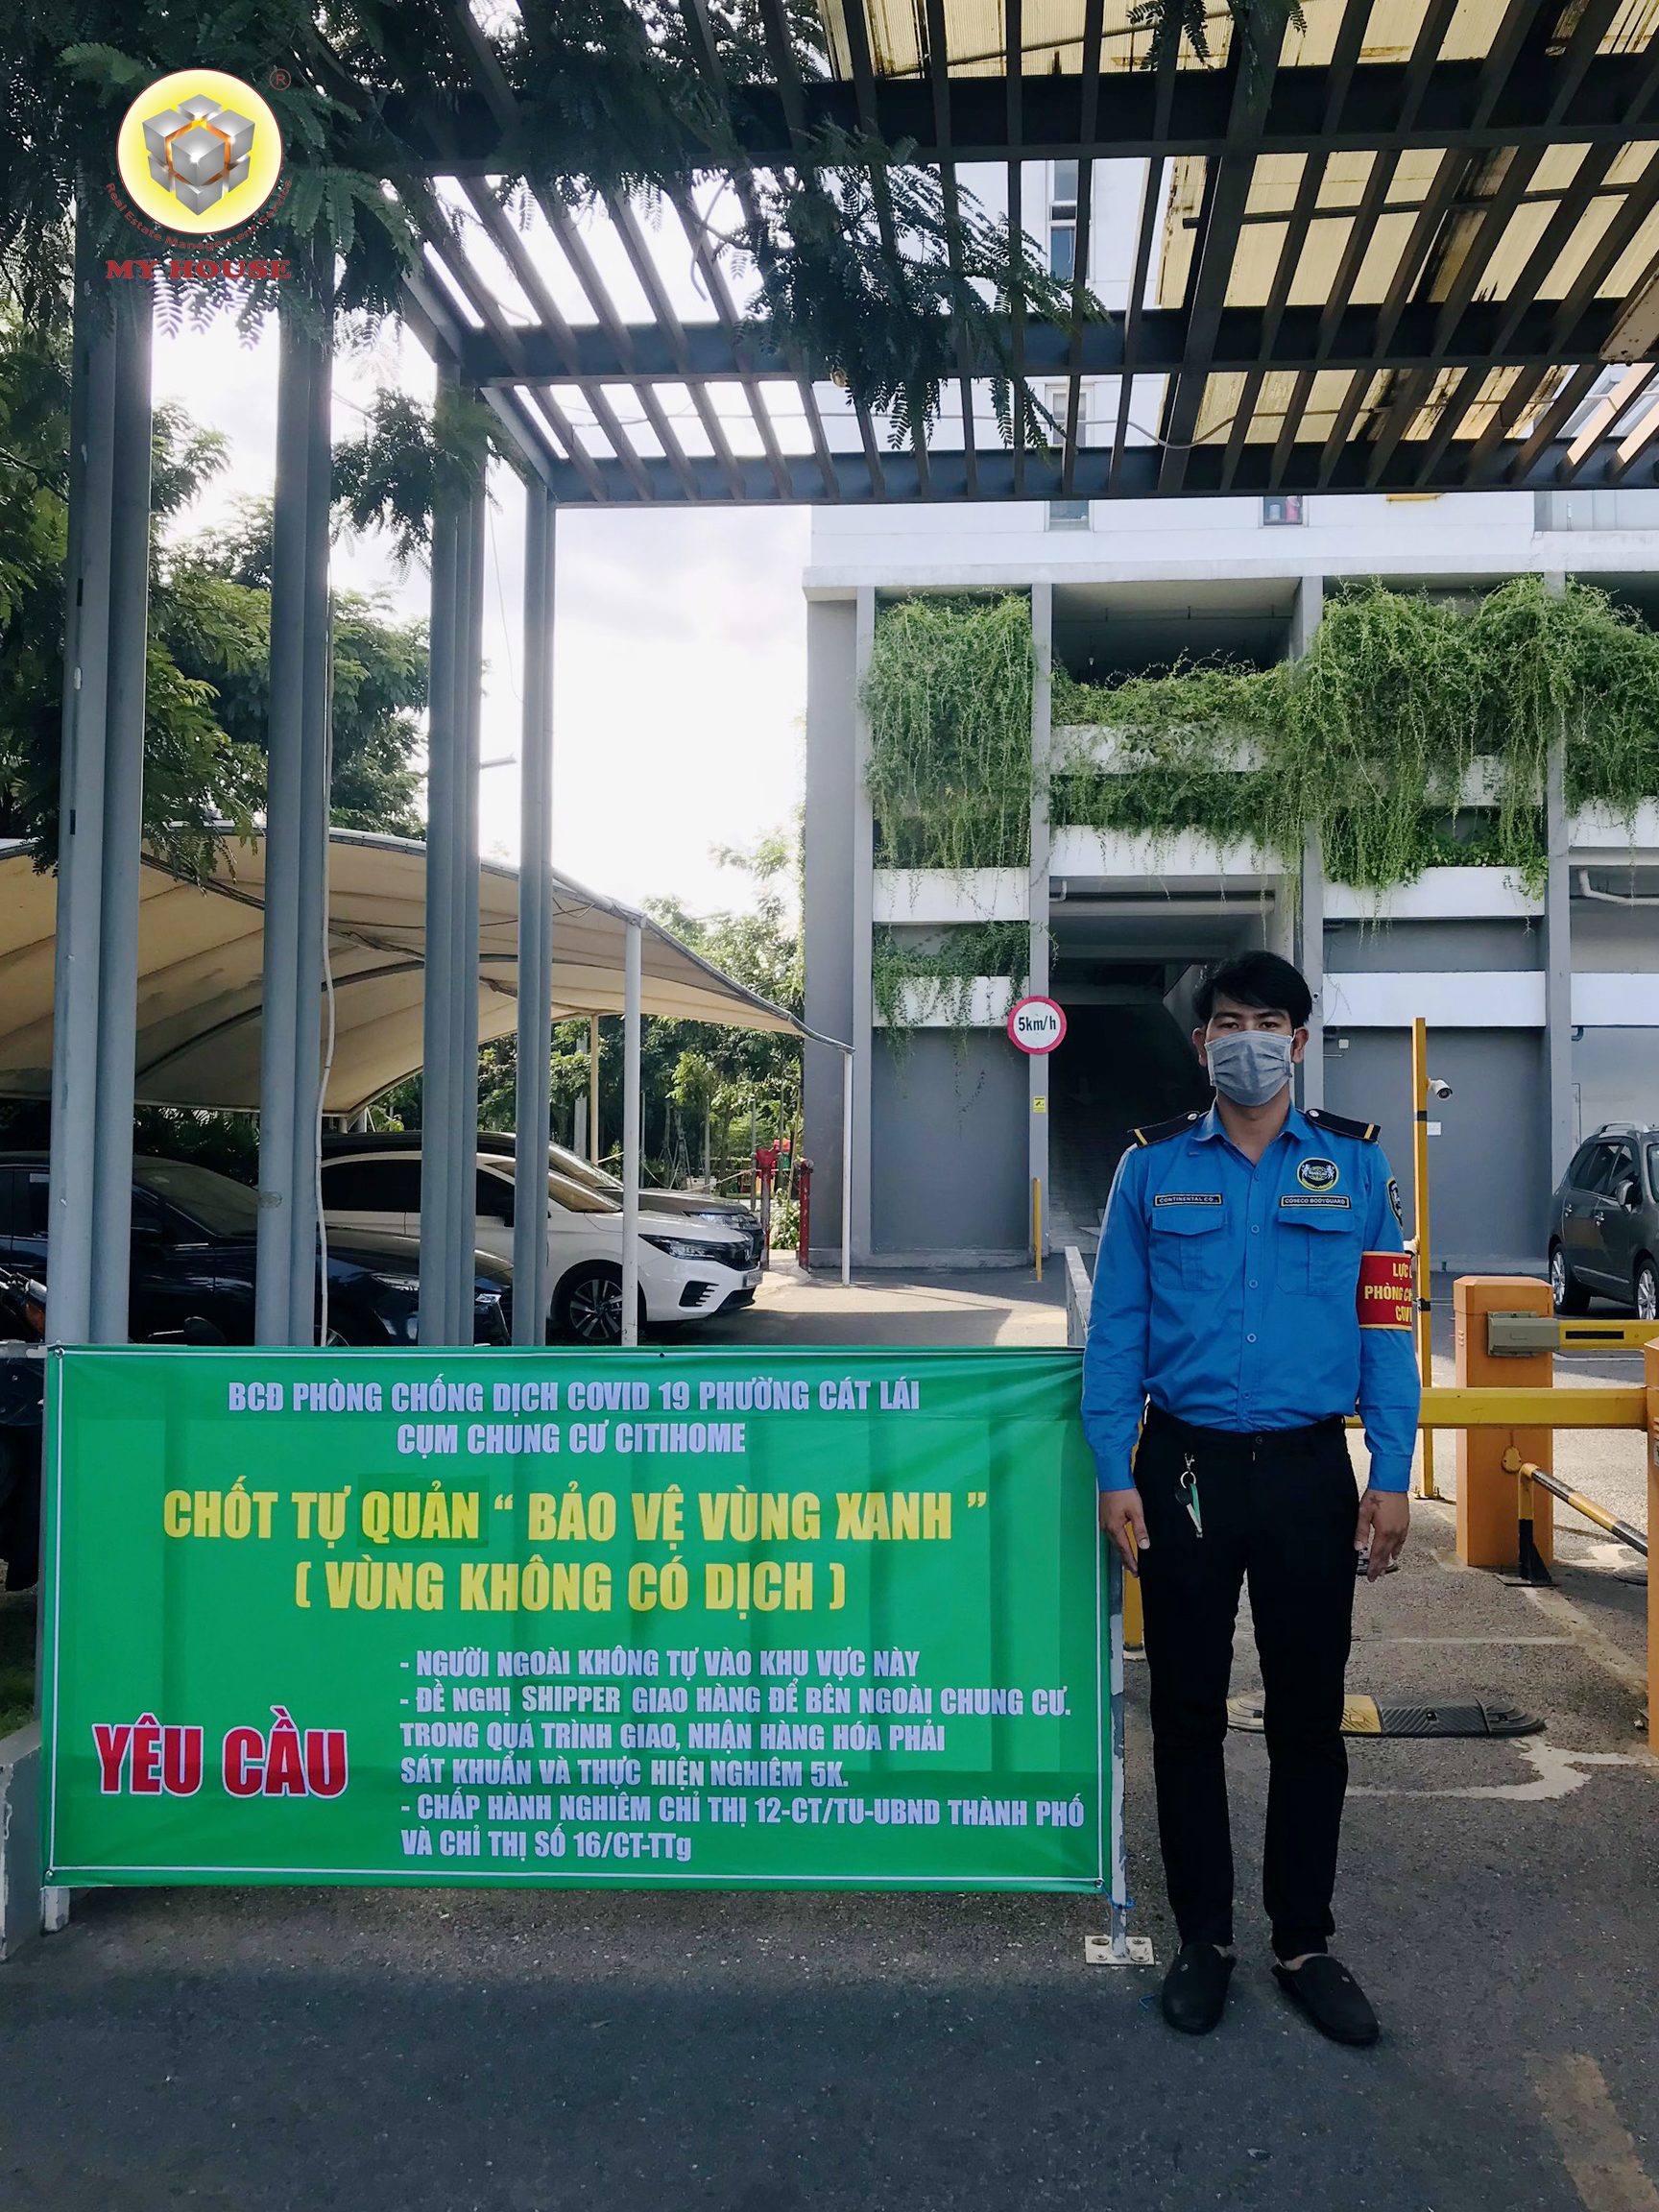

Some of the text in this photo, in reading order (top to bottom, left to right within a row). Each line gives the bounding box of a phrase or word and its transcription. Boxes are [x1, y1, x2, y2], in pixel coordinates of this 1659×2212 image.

[1019, 1015, 1056, 1031] 5km/h
[1364, 1282, 1404, 1301] PHÒNG
[228, 1373, 920, 1417] BCĐ PHÒNG CHỐNG DỊCH COVID 19 PHƯỜNG CÁT LÁI
[397, 1419, 746, 1459] CỤM CHUNG CƯ CITIHOME
[163, 1475, 279, 1539] CHỐT
[291, 1484, 352, 1550] TỰ
[361, 1479, 479, 1544] QUẢN
[528, 1479, 617, 1542] BẢO
[631, 1483, 685, 1551] VỆ
[698, 1484, 821, 1542] VÙNG
[835, 1491, 953, 1540] XANH
[296, 1553, 846, 1621] ( VÙNG KHÔNG CÓ DỊCH )
[417, 1646, 490, 1677] NGƯỜI
[497, 1647, 570, 1676] NGOÀI
[578, 1644, 660, 1677] KHÔNG
[666, 1646, 700, 1682] TỰ
[704, 1646, 752, 1677] VÀO
[759, 1649, 809, 1676] KHU
[815, 1646, 866, 1682] VỰC
[874, 1646, 921, 1677] NÀY
[416, 1678, 445, 1713] ĐỀ
[452, 1687, 511, 1716] NGHỊ
[521, 1685, 621, 1714] SHIPPER
[632, 1686, 688, 1714] GIAO
[696, 1682, 761, 1714] HÀNG
[768, 1677, 799, 1714] ĐỂ
[805, 1682, 851, 1715] BÊN
[858, 1683, 932, 1716] NGOÀI
[940, 1687, 1023, 1717] CHUNG
[1031, 1685, 1072, 1717] CƯ.
[91, 1704, 349, 1799] YÊU CẦU
[399, 1719, 946, 1754] TRONG QUÁ TRÌNH GIAO, NHẬN HÀNG HÓA PHẢI
[400, 1750, 849, 1791] SÁT KHUẨN VÀ THỰC HIỆN NGHIÊM 5K.
[418, 1787, 480, 1820] CHẤP
[488, 1791, 552, 1821] HÀNH
[560, 1791, 651, 1822] NGHIÊM
[659, 1791, 701, 1823] CHỈ
[707, 1796, 748, 1828] THỊ
[755, 1796, 940, 1825] 12-CT/TU-UBND
[947, 1795, 1027, 1827] THÀNH
[1036, 1792, 1085, 1828] PHỐ
[400, 1823, 692, 1863] VÀ CHỈ THỊ SỐ 16/CT-TTg
